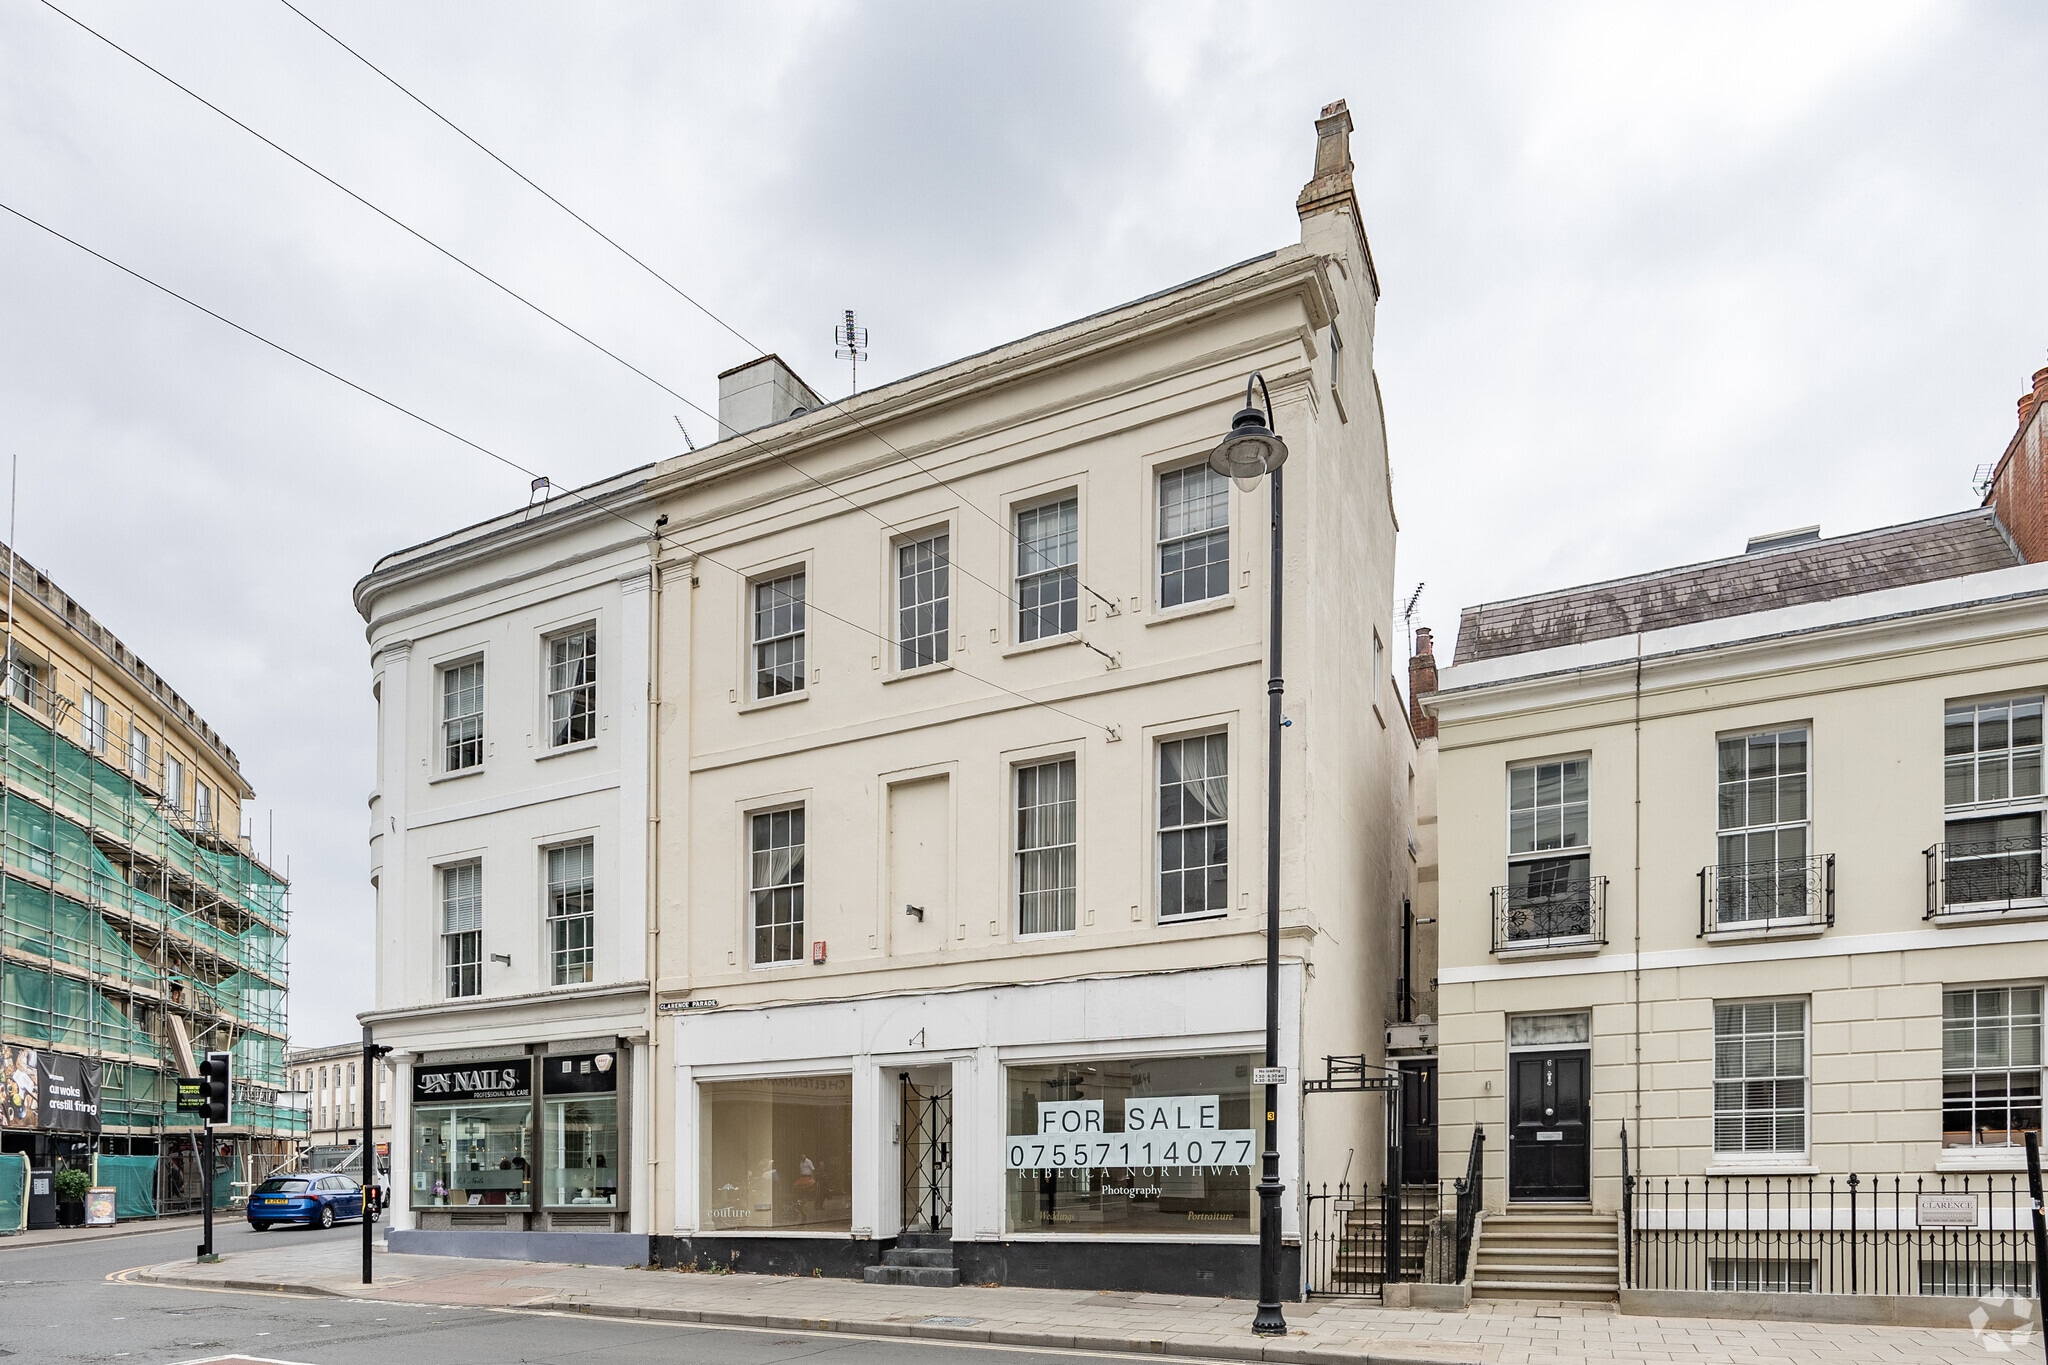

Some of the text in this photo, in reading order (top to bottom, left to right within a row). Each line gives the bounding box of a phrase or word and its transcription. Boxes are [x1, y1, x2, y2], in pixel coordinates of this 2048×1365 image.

[1546, 1059, 1552, 1067] 6
[418, 1068, 517, 1093] TN NAILS
[1420, 1071, 1428, 1083] 7
[60, 1086, 81, 1098] woks
[1043, 1105, 1215, 1133] FOR SALE
[1268, 1112, 1274, 1120] 3
[1010, 1140, 1251, 1167] 07557114077
[1018, 1164, 1252, 1179] REBECCA NORTHWAY
[1101, 1184, 1163, 1199] Photography
[707, 1205, 751, 1218] couture
[1040, 1210, 1234, 1223] Weddings Portraiture
